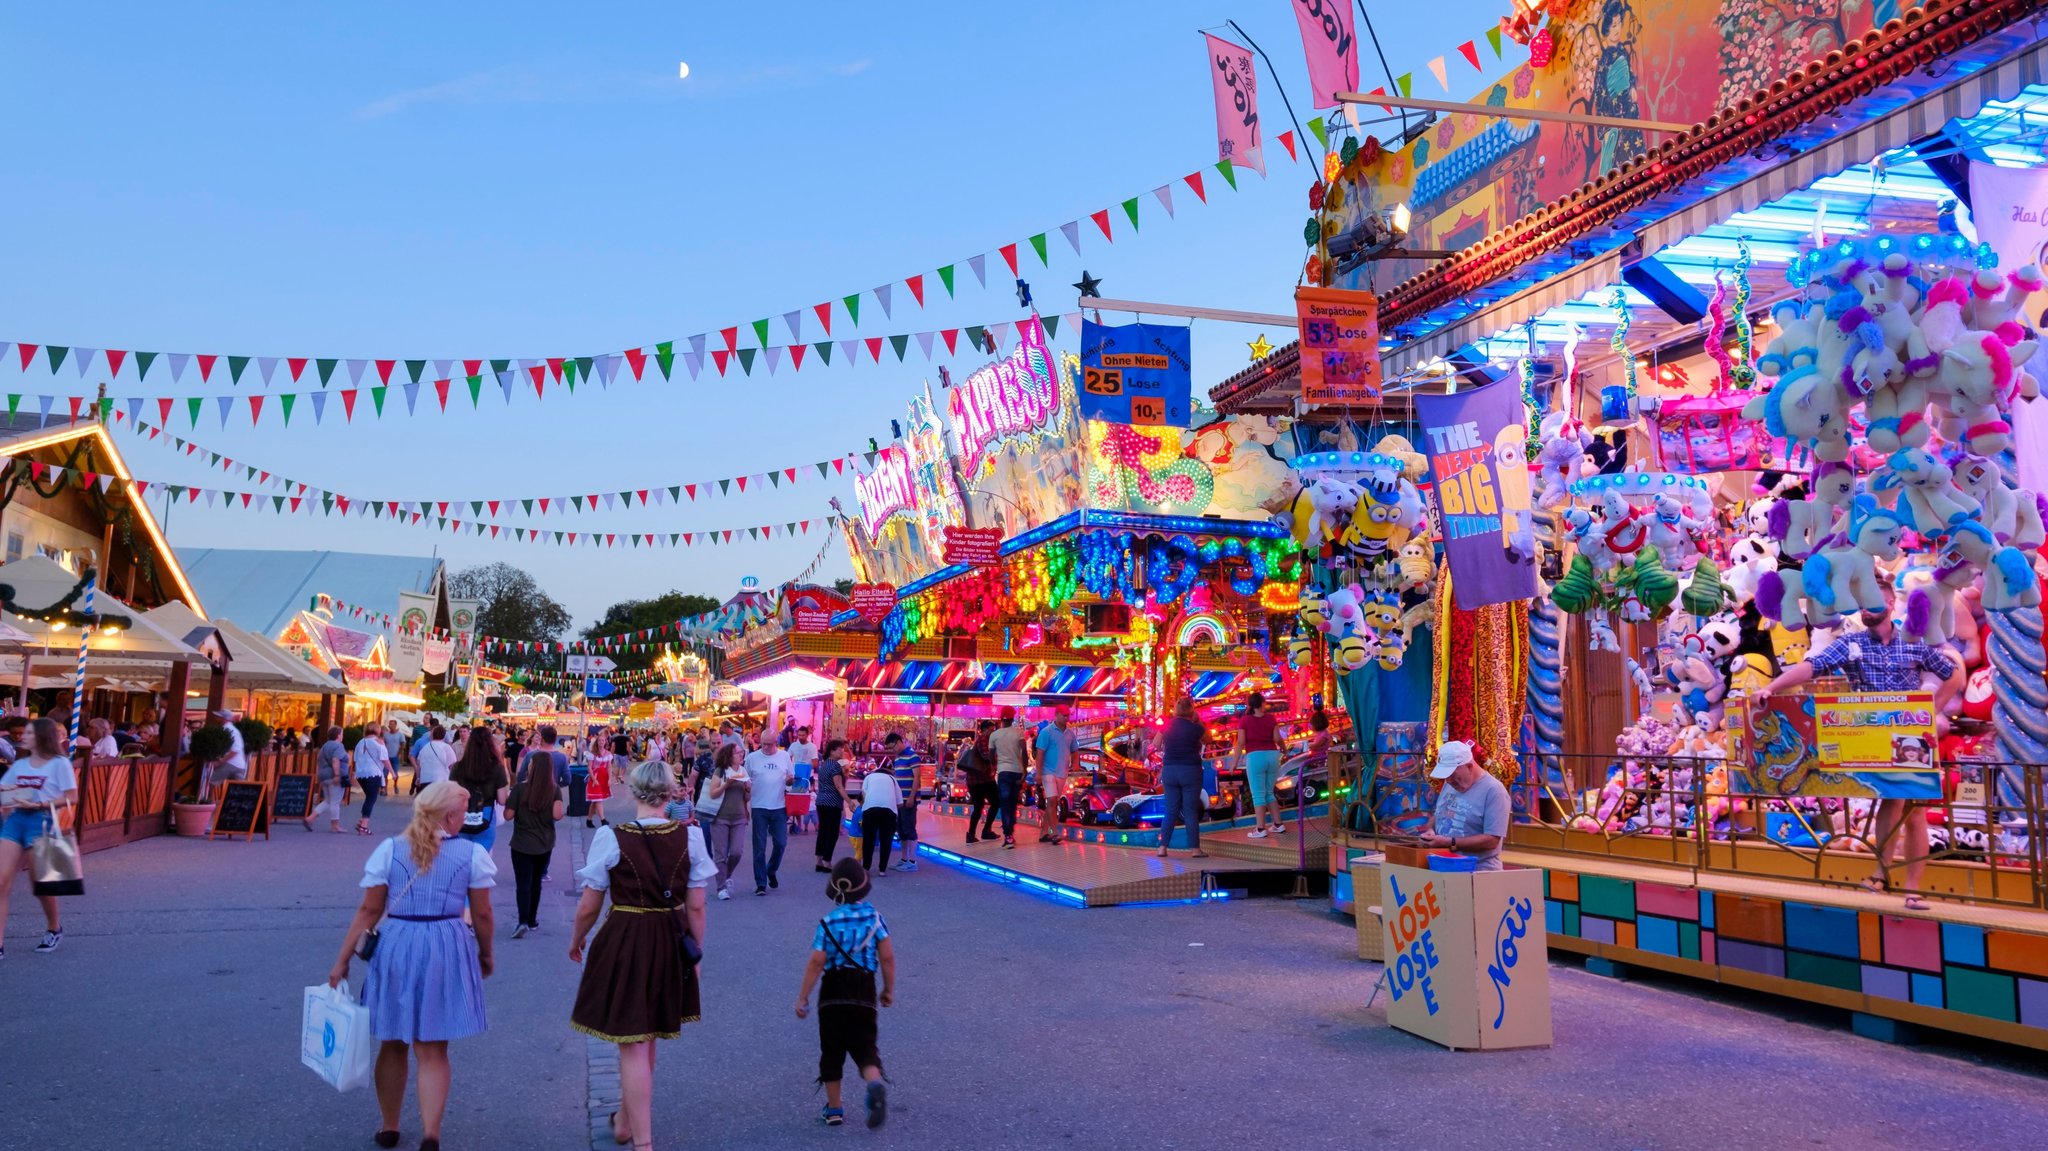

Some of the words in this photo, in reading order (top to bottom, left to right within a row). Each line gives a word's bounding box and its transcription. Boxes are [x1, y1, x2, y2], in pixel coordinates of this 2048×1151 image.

[2012, 206, 2037, 222] Has
[1310, 304, 1368, 317] Sparpäckchen
[1308, 322, 1335, 343] 55
[1337, 326, 1368, 339] Lose
[1081, 339, 1116, 361] Achtung
[1104, 356, 1131, 366] Ohne
[1135, 356, 1167, 367] Nieten
[1153, 337, 1191, 372] Achtung
[1364, 361, 1372, 375] €
[1087, 370, 1121, 393] 25
[1128, 378, 1161, 389] Lose
[948, 313, 1058, 478] EXPRESS
[1306, 386, 1380, 401] Familienangebot
[1134, 404, 1162, 421] 10,-
[1170, 406, 1178, 418] €
[1426, 420, 1483, 454] THE
[1432, 442, 1491, 483] NEXT
[854, 445, 918, 534] ORIENT
[1438, 462, 1498, 516] BIG
[1446, 514, 1502, 540] THING
[872, 588, 891, 596] Eltern
[1837, 696, 1862, 704] JEDEN
[1863, 695, 1907, 703] MITTWOCH
[1821, 709, 1932, 728] KINDERTAG
[1390, 874, 1407, 908] L
[1389, 881, 1441, 954] LOSE
[1386, 930, 1440, 1002] LOSE
[1421, 976, 1439, 1017] E
